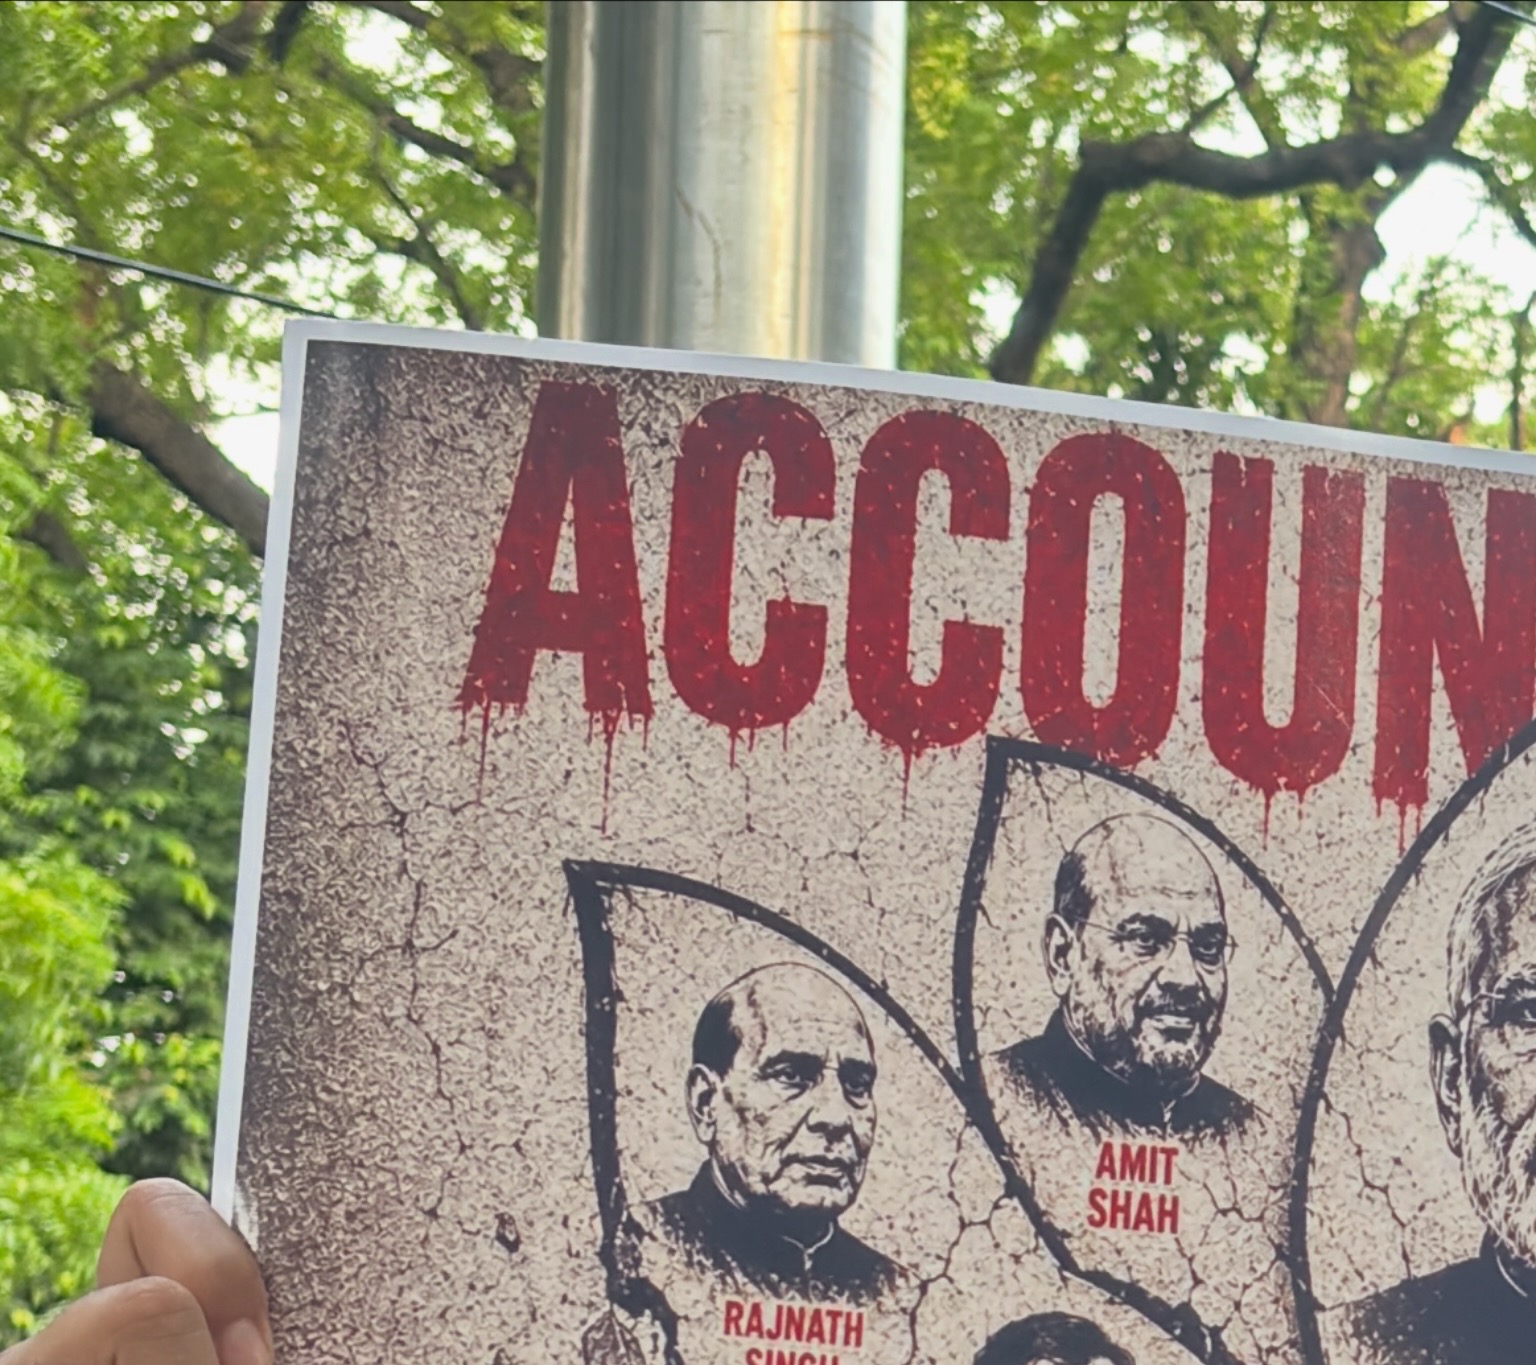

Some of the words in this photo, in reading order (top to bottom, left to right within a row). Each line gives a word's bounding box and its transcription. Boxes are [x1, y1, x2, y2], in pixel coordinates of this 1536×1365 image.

[1095, 1141, 1179, 1186] AMIT
[1087, 1187, 1180, 1234] SHAH
[723, 1299, 865, 1348] RAJNATH
